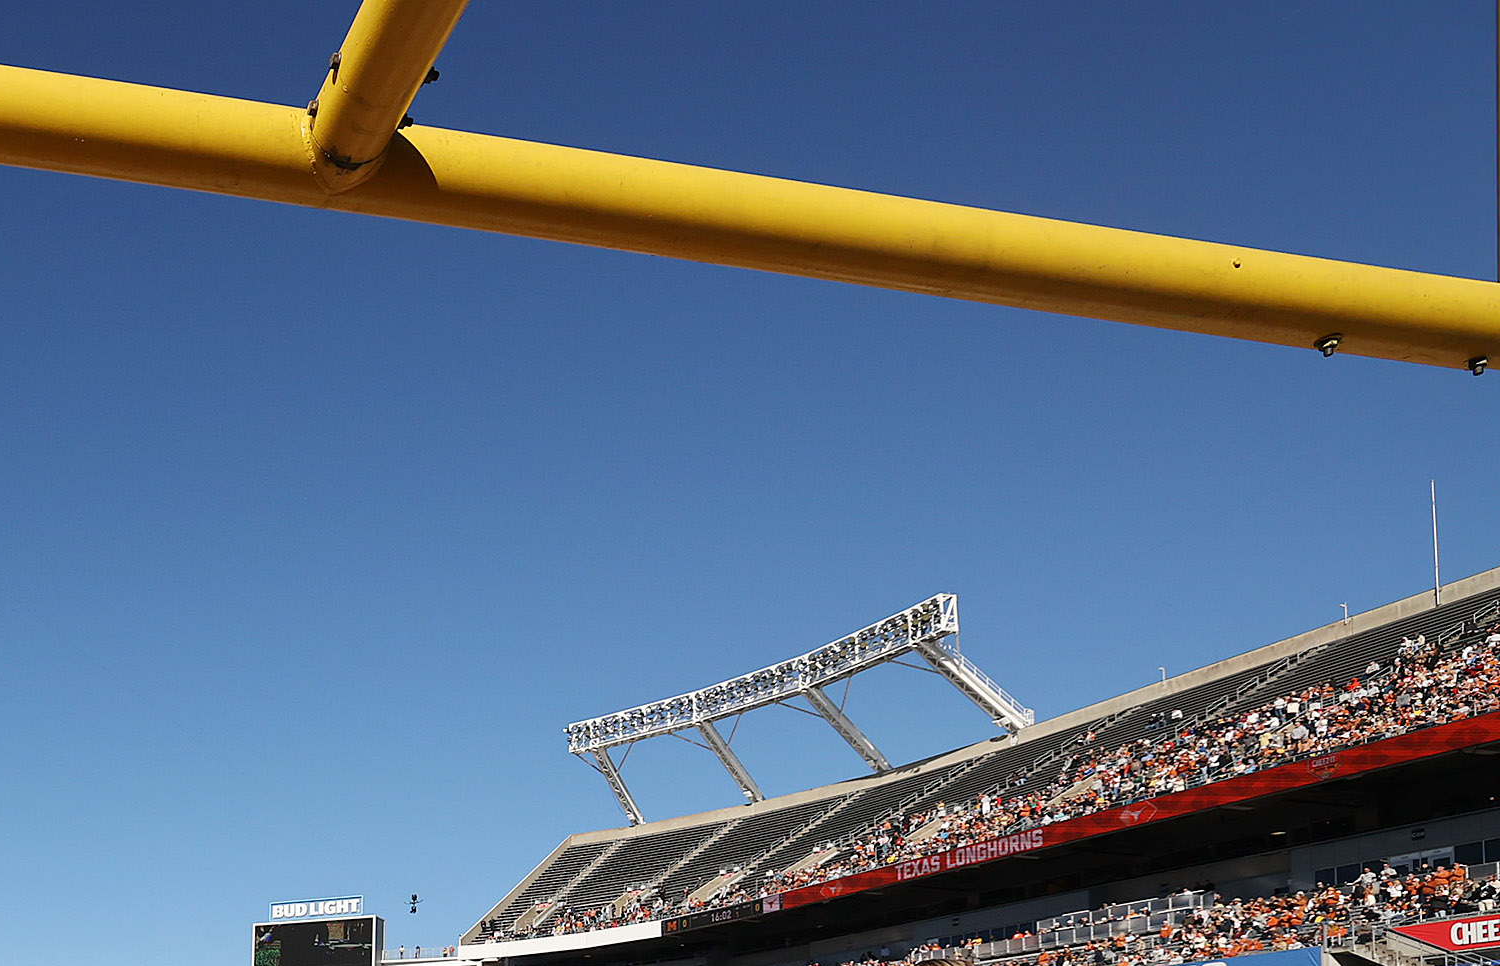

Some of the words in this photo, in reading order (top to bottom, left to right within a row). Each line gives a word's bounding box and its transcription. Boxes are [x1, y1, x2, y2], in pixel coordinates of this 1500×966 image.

[895, 855, 940, 880] TEXAS
[946, 829, 1043, 868] LONGHORNS
[272, 903, 308, 919] BUD
[309, 898, 360, 915] LIGHT
[711, 910, 732, 922] 16:02
[1450, 920, 1500, 945] CHEE
